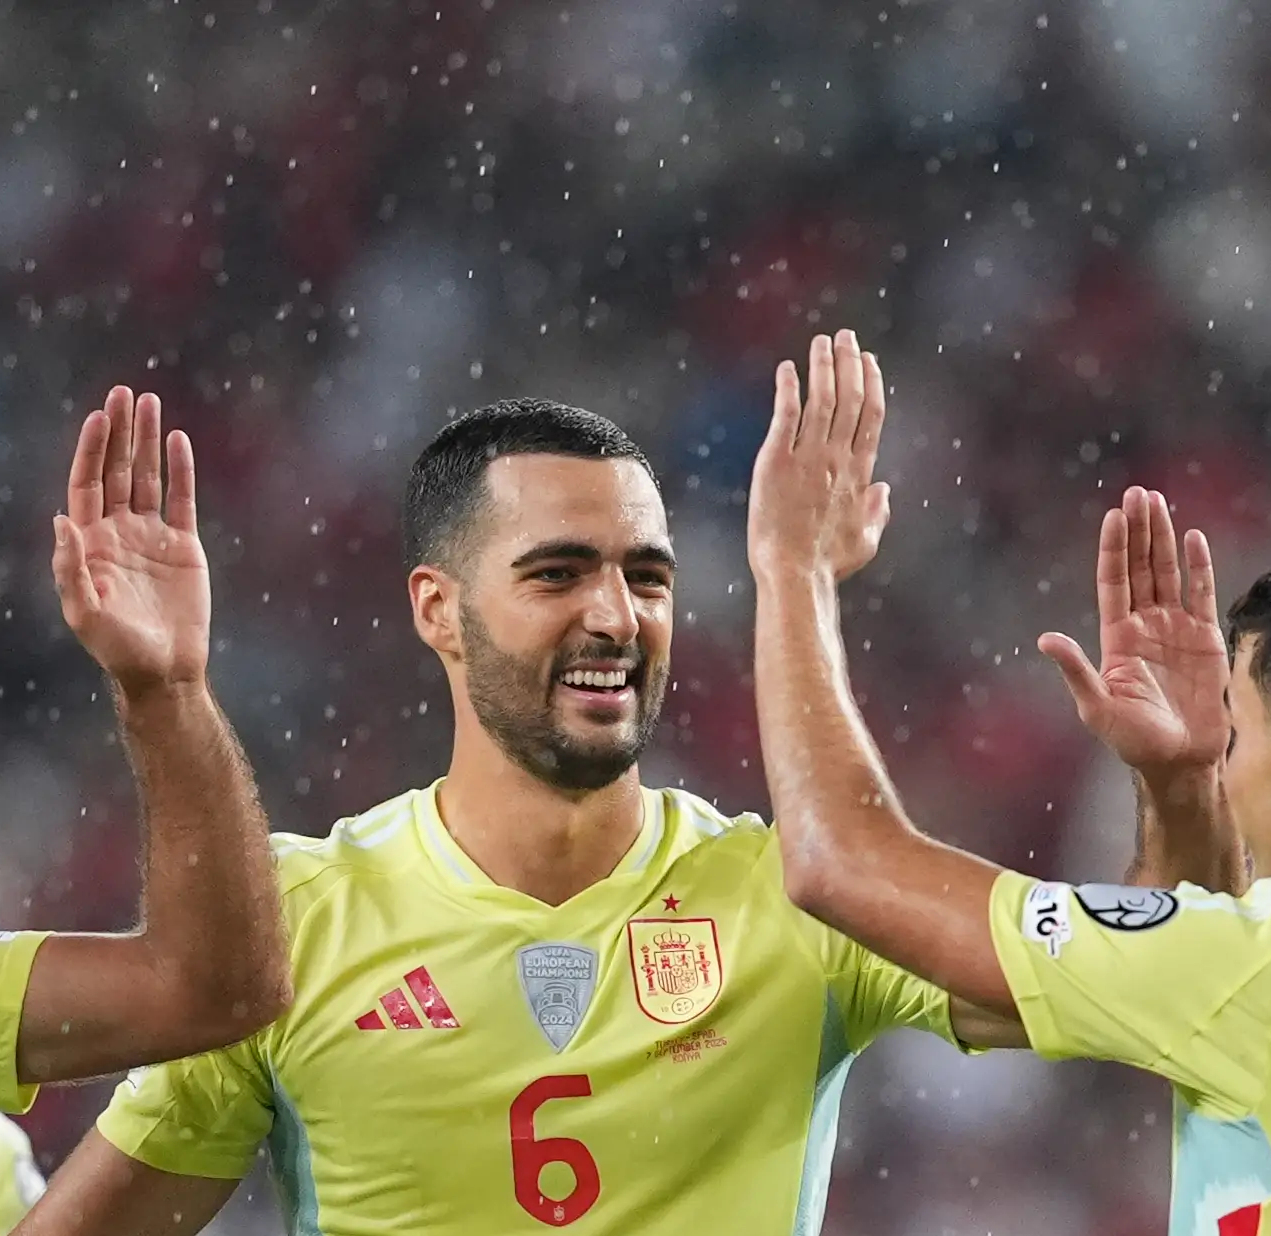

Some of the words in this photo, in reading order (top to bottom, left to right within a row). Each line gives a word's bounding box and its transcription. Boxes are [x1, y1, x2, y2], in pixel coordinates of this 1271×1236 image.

[543, 947, 571, 958] UEFA
[525, 957, 590, 969] EUROPEAN
[526, 967, 591, 979] CHAMPIONS
[542, 1014, 574, 1026] 2024
[510, 1074, 600, 1227] 6
